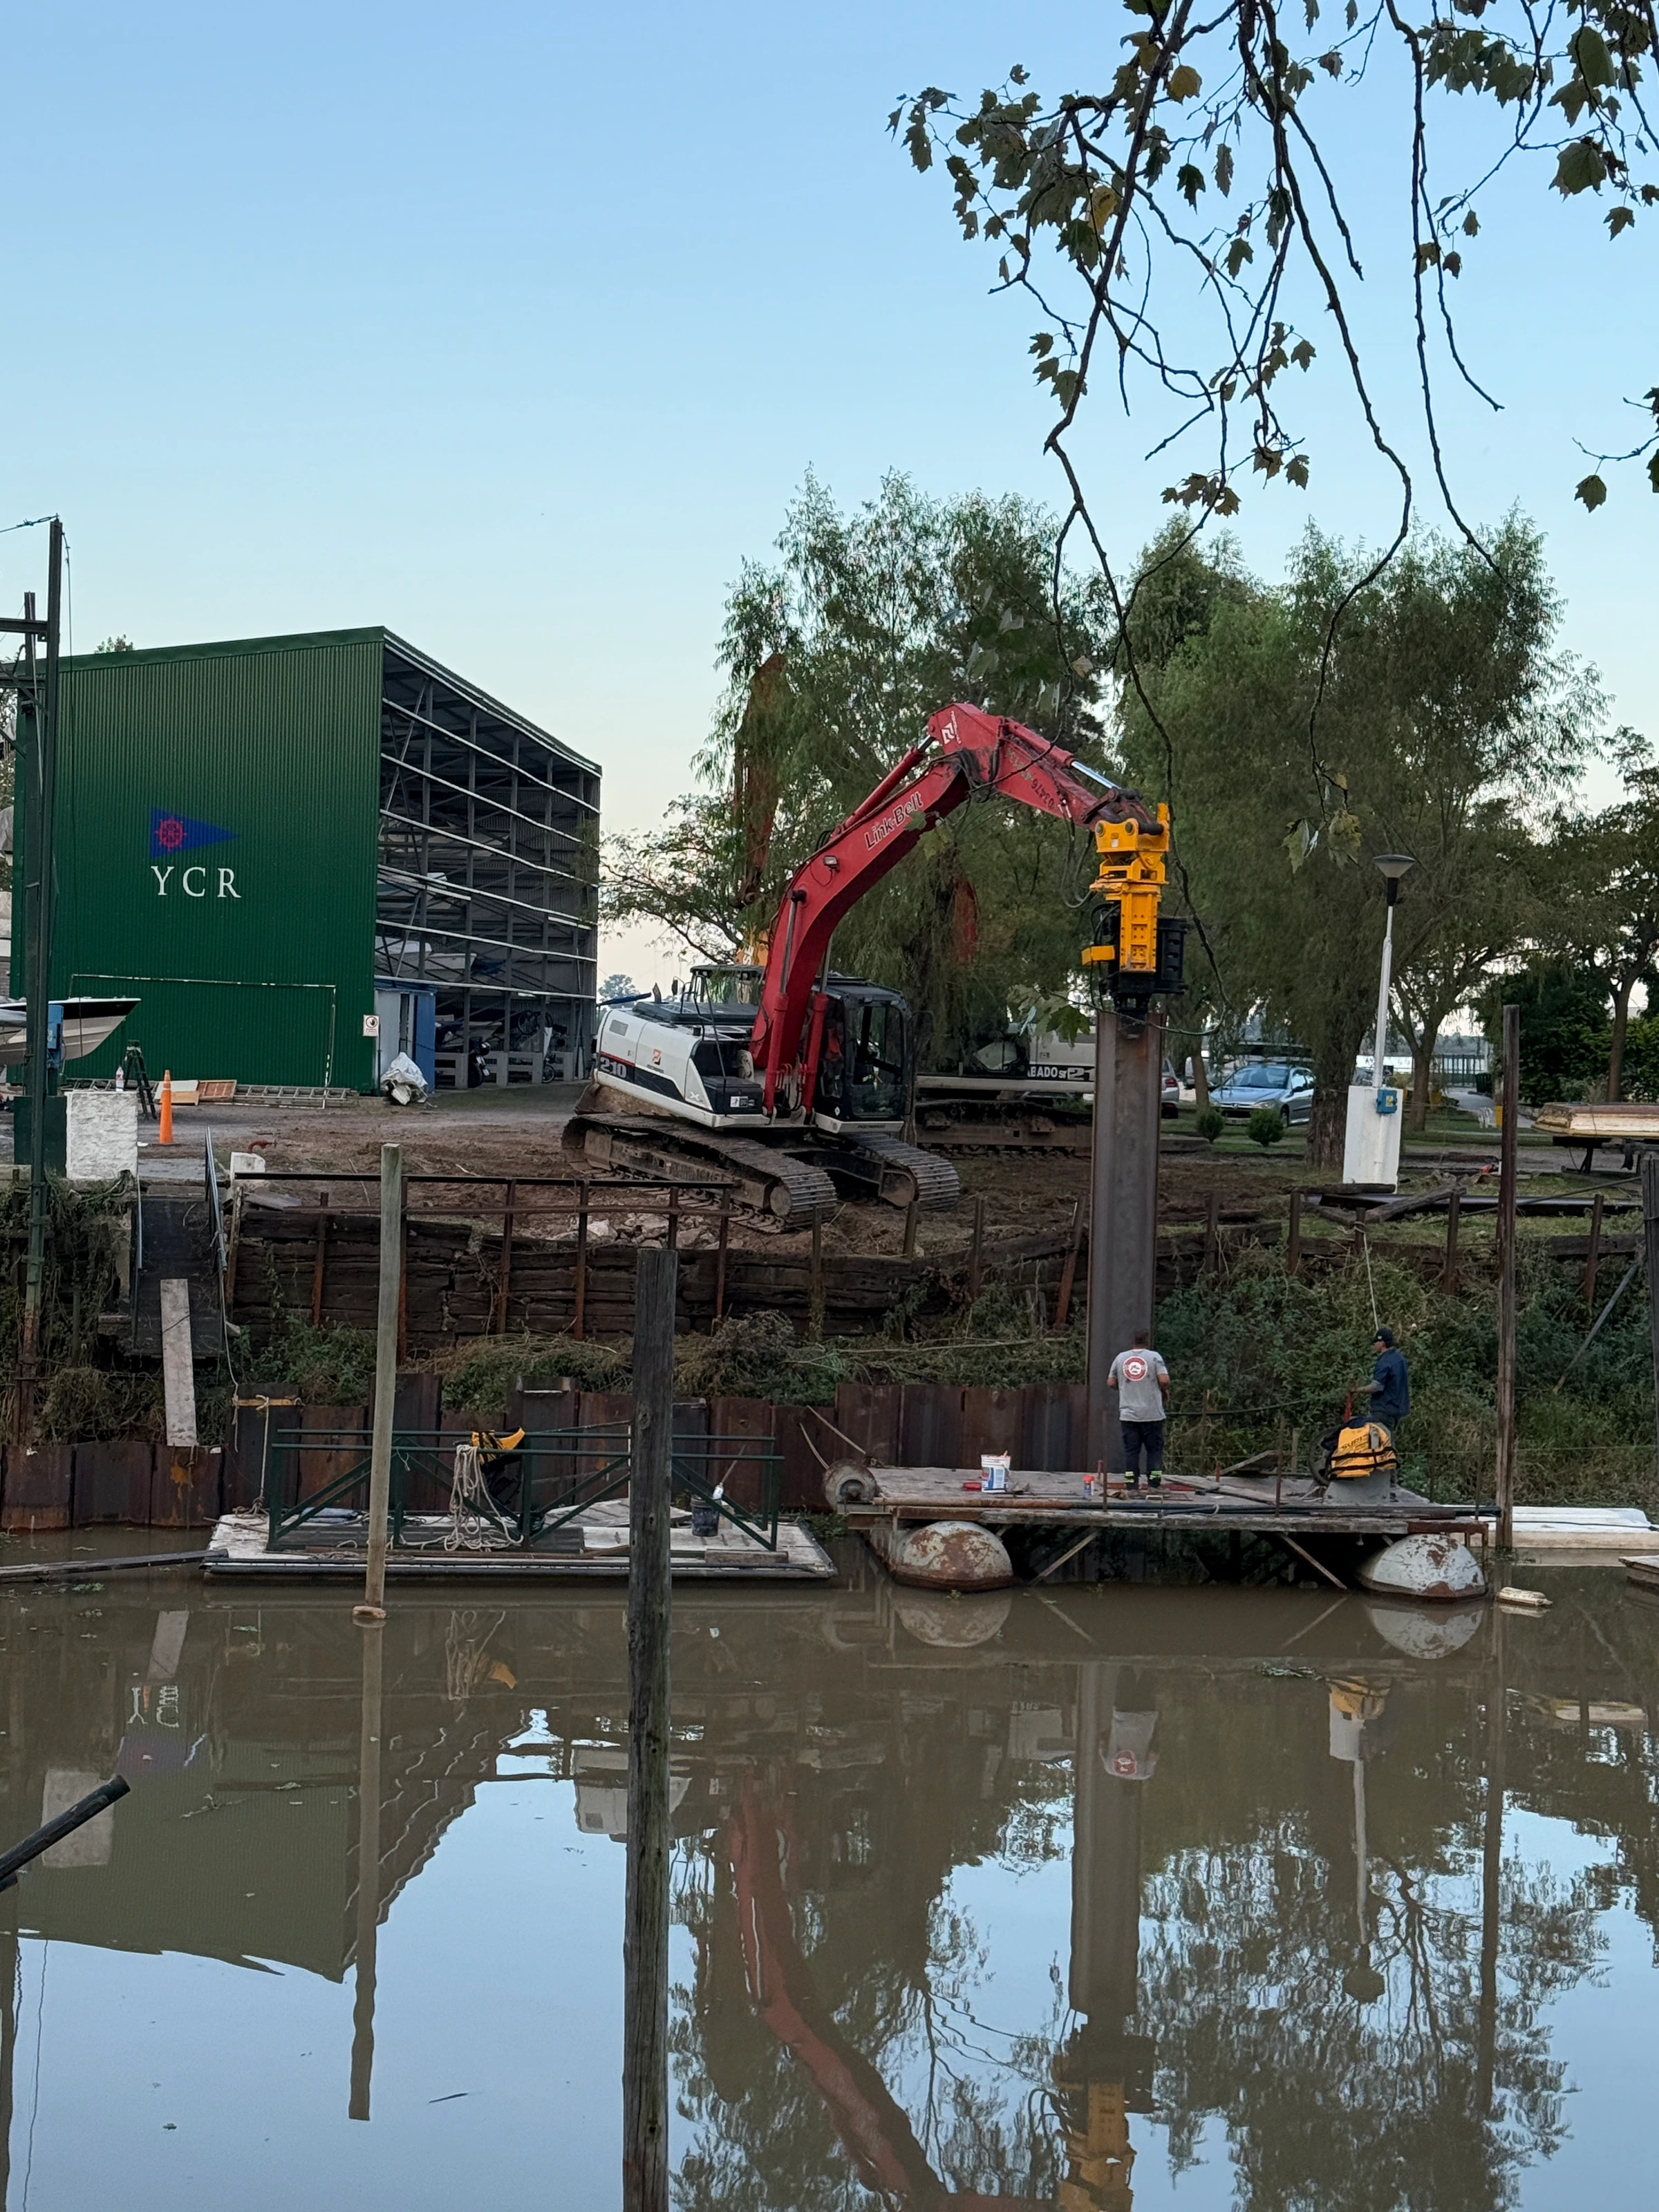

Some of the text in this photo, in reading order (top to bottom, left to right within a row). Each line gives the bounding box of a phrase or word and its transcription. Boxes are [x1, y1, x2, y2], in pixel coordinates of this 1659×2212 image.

[864, 791, 924, 851] Link-Belt
[150, 865, 242, 898] YCR
[600, 1057, 627, 1078] 210
